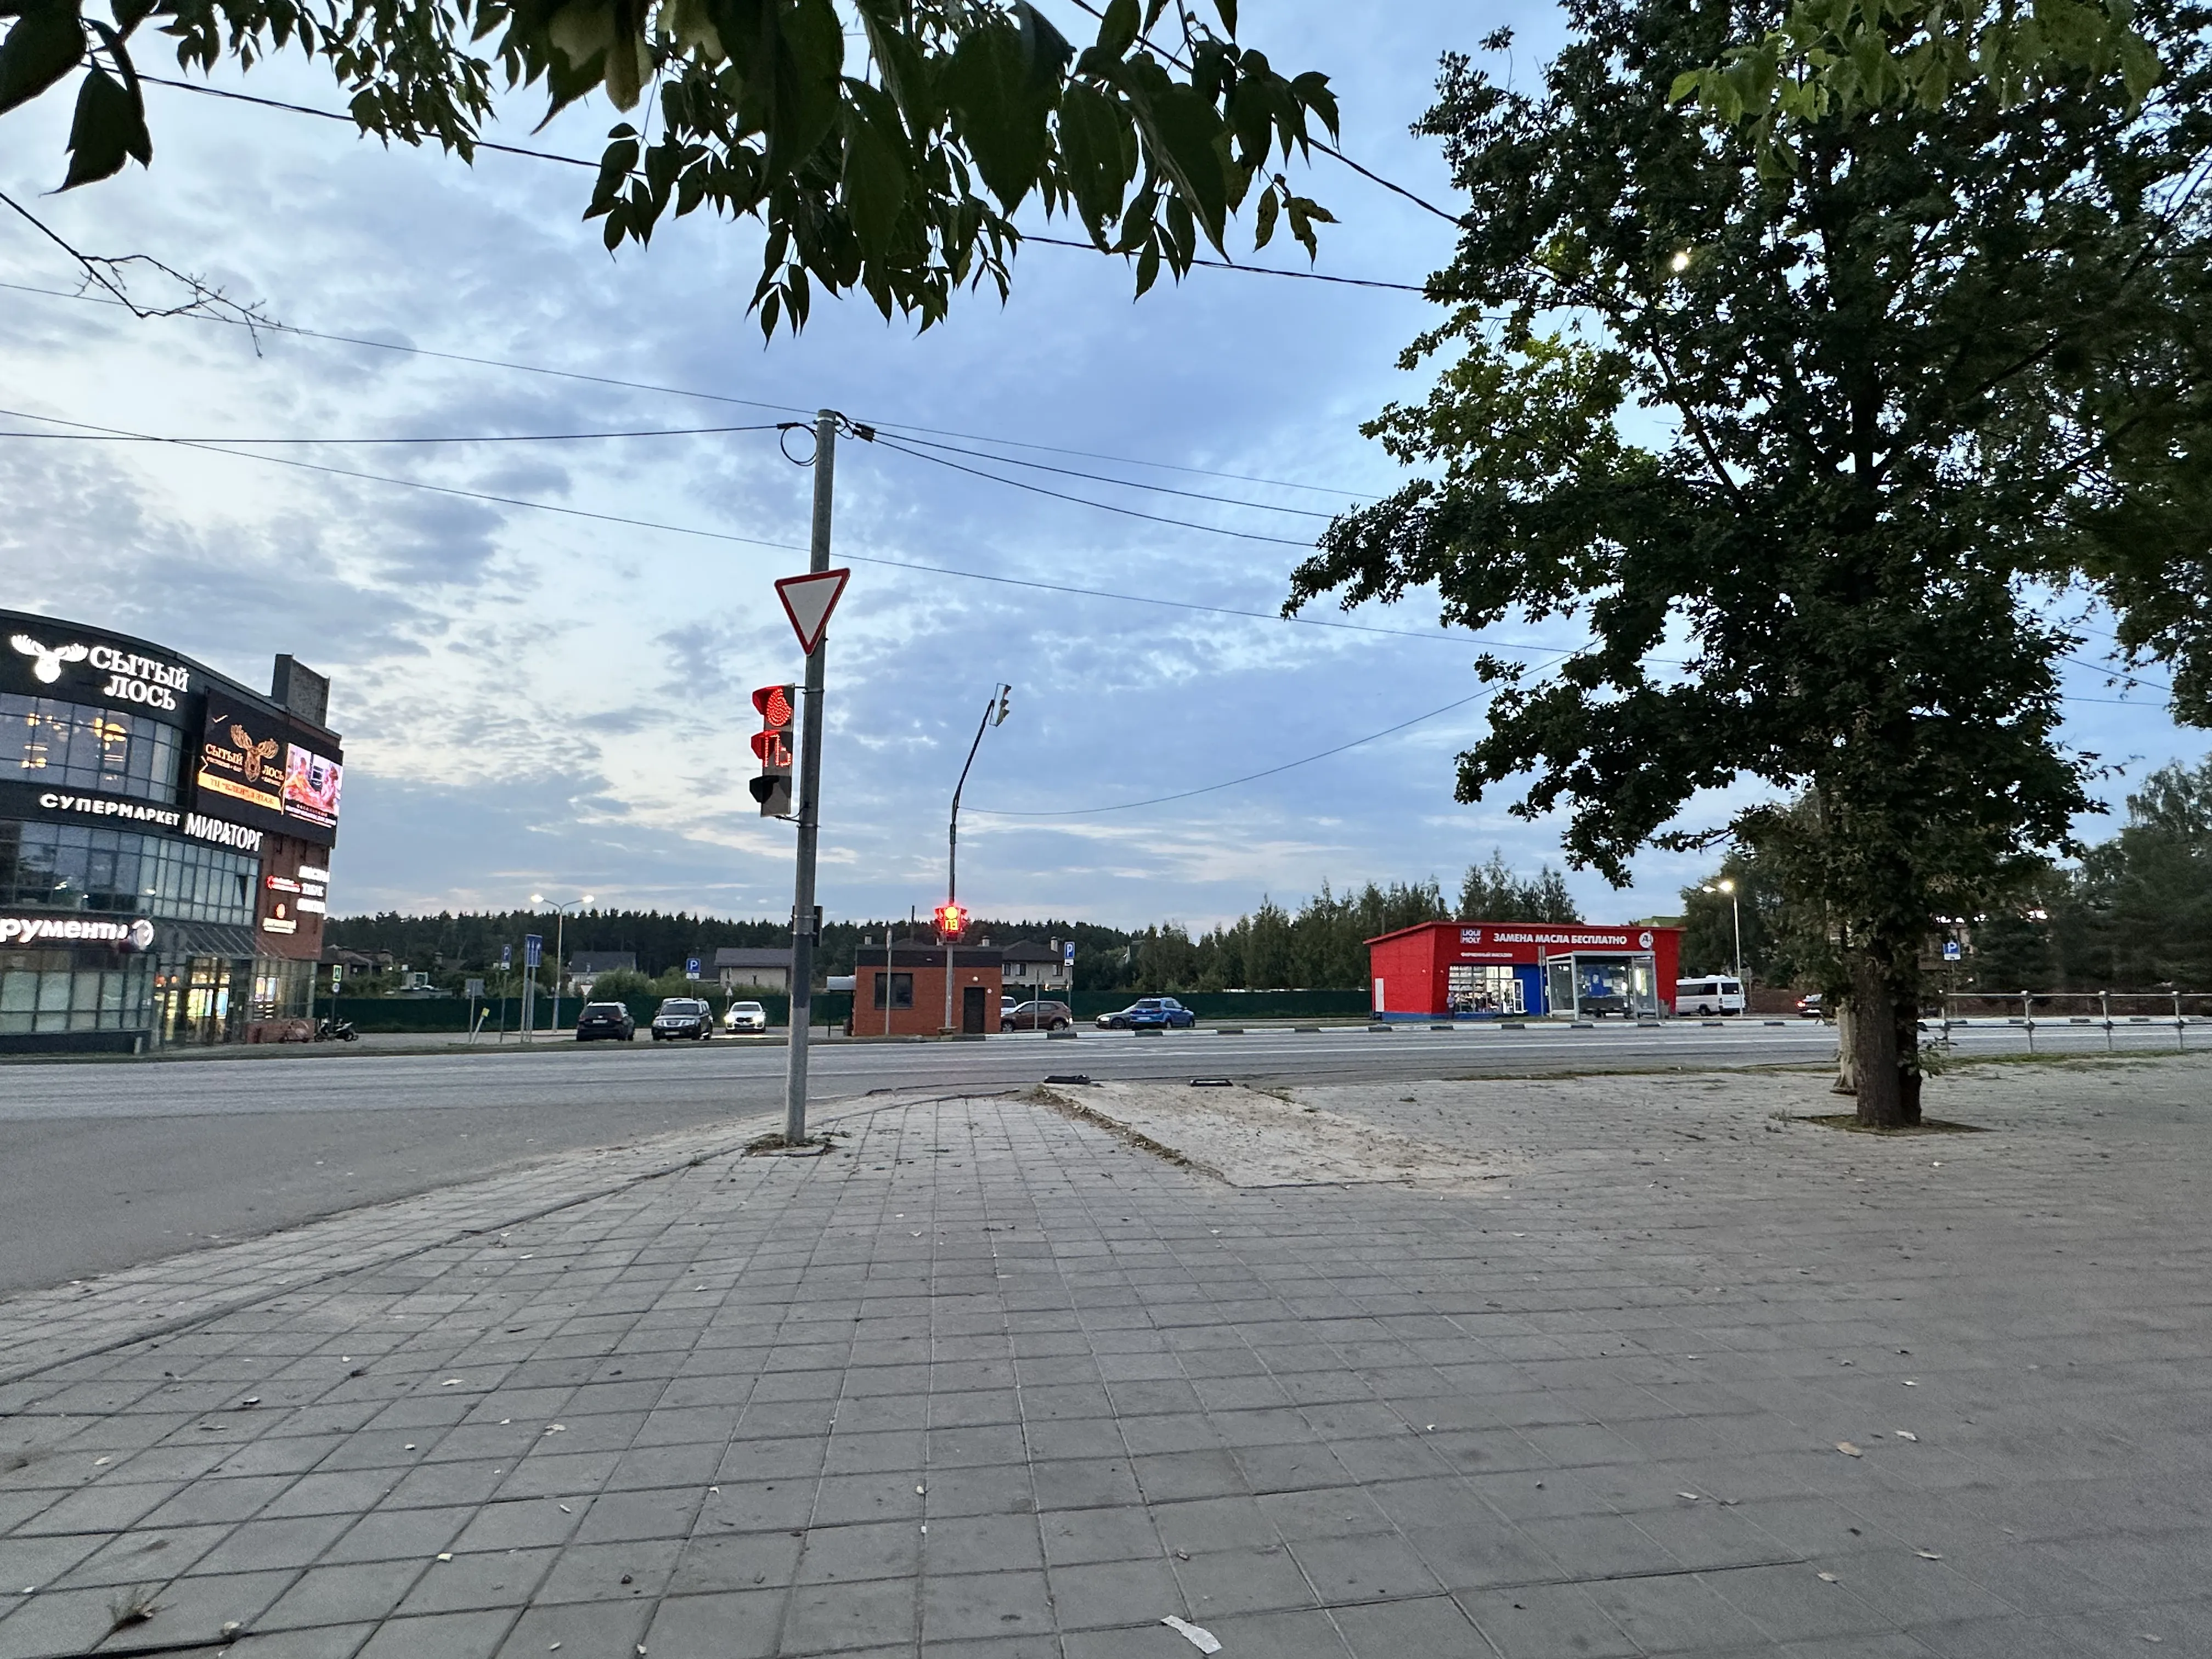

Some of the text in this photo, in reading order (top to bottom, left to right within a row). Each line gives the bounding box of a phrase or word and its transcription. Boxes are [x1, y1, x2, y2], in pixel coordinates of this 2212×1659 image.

[90, 646, 190, 692] СЫТЫЙ
[104, 675, 176, 710] ЛОСЬ
[205, 743, 244, 766] СЫТЫЙ
[40, 793, 180, 826] СУПЕРМАРКЕТ
[184, 812, 263, 852] МИРАТОРГ
[1493, 933, 1628, 945] ЗАМЕНА МАСЛА БЕСПЛАТНО
[504, 946, 510, 960] P
[1066, 944, 1073, 957] P
[1948, 942, 1957, 952] P
[690, 960, 698, 970] P
